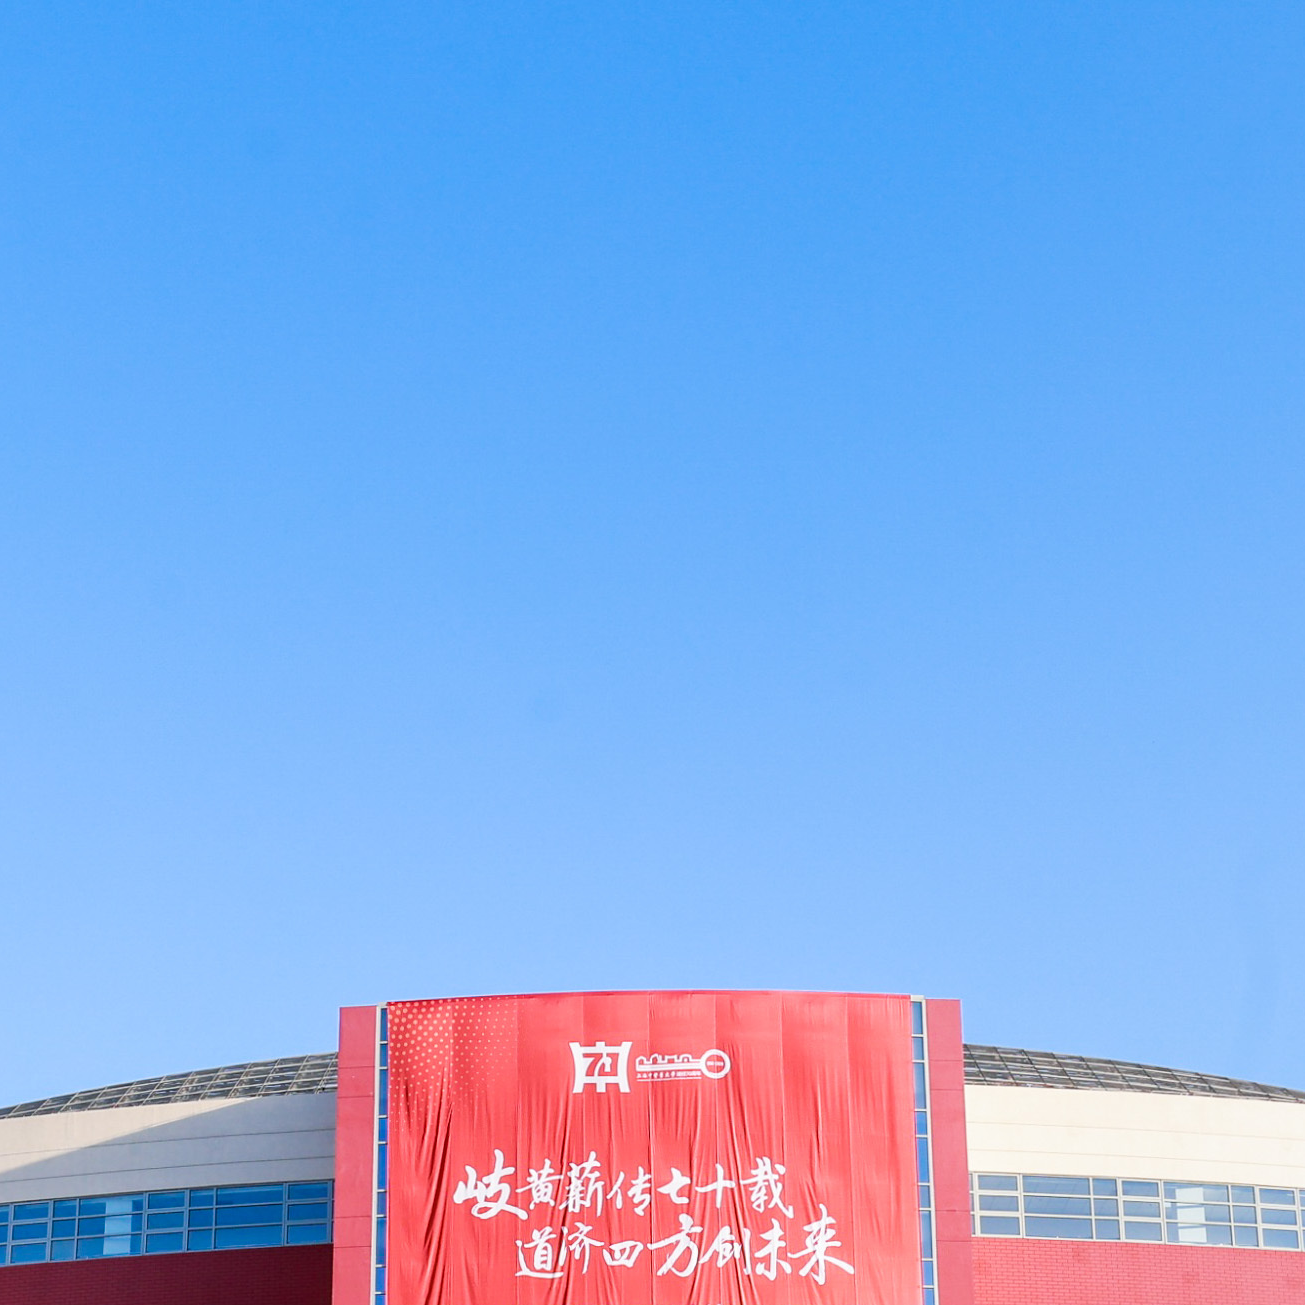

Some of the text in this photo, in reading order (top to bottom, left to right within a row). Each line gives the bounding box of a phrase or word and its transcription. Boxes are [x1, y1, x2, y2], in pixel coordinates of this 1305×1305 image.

[453, 1148, 794, 1221] 岐黄薪传七十载
[515, 1201, 855, 1287] 道济四方创未来
